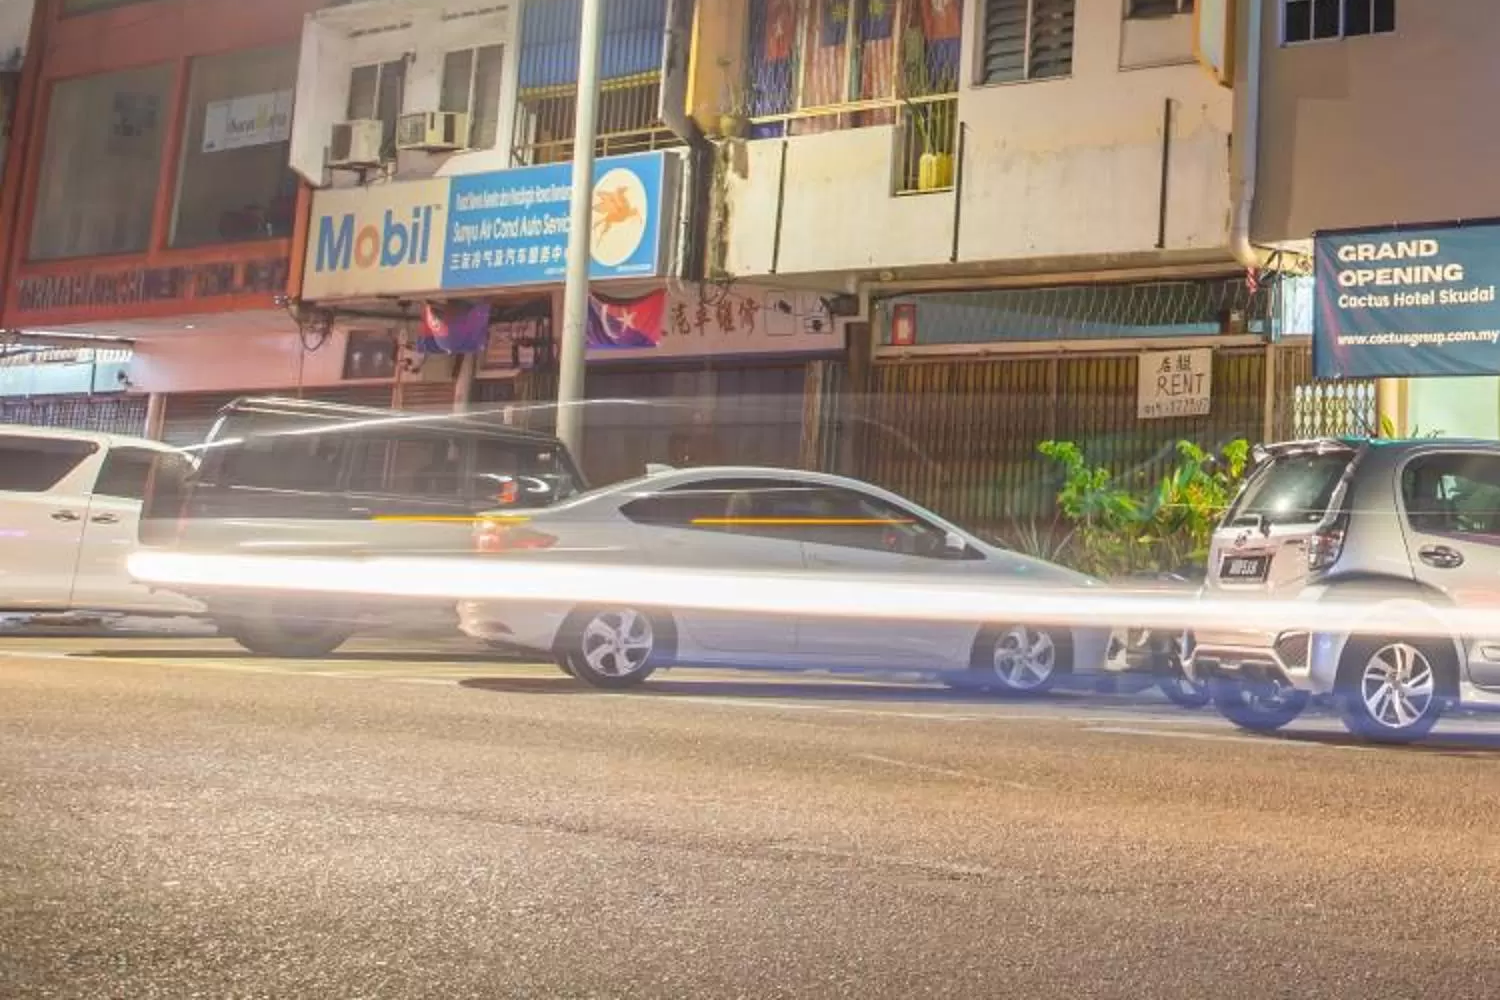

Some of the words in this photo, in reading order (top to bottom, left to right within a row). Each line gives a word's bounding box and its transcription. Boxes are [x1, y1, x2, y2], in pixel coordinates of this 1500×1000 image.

[316, 205, 432, 272] Mobil
[493, 217, 519, 241] Cond
[520, 215, 541, 237] Auto
[543, 213, 573, 235] Servic
[1337, 238, 1439, 263] GRAND
[1337, 263, 1465, 288] OPENING
[1337, 291, 1390, 309] Cactus
[1393, 290, 1436, 307] Hotel
[1438, 286, 1496, 304] Skudai
[1337, 329, 1500, 348] www.cactusgroup.com.my
[1155, 372, 1205, 397] RENT
